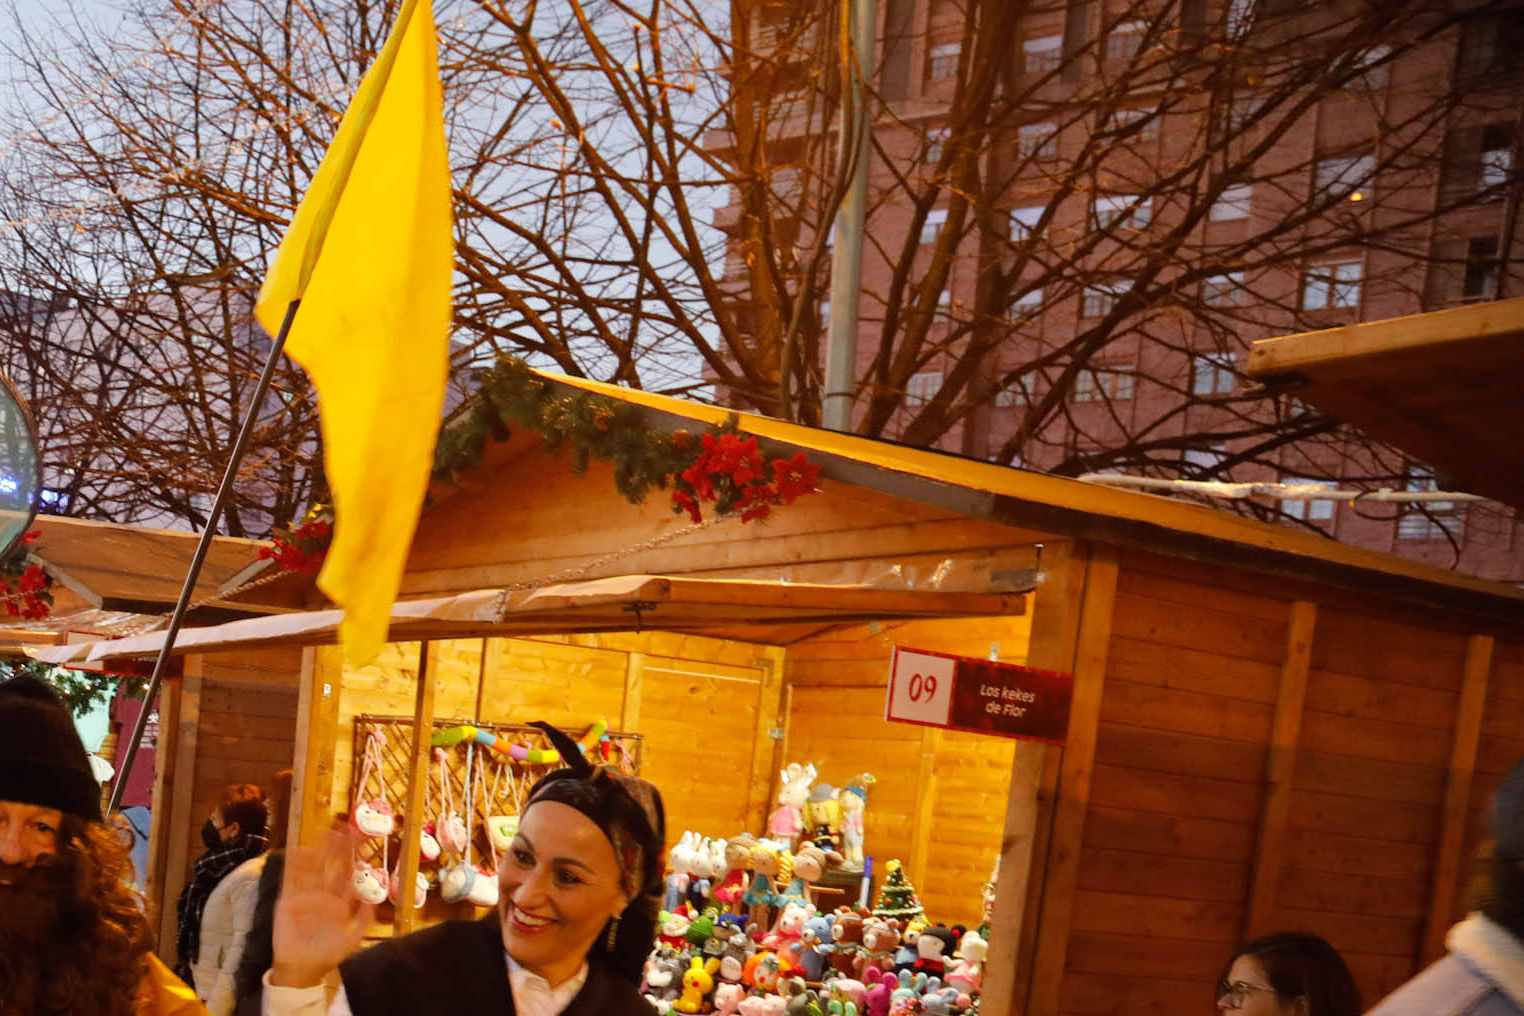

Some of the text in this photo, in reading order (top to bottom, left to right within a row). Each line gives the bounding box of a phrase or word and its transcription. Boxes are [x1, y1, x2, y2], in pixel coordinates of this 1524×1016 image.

[908, 673, 938, 704] 09
[1001, 685, 1036, 703] kekes
[985, 701, 1027, 718] de Flor
